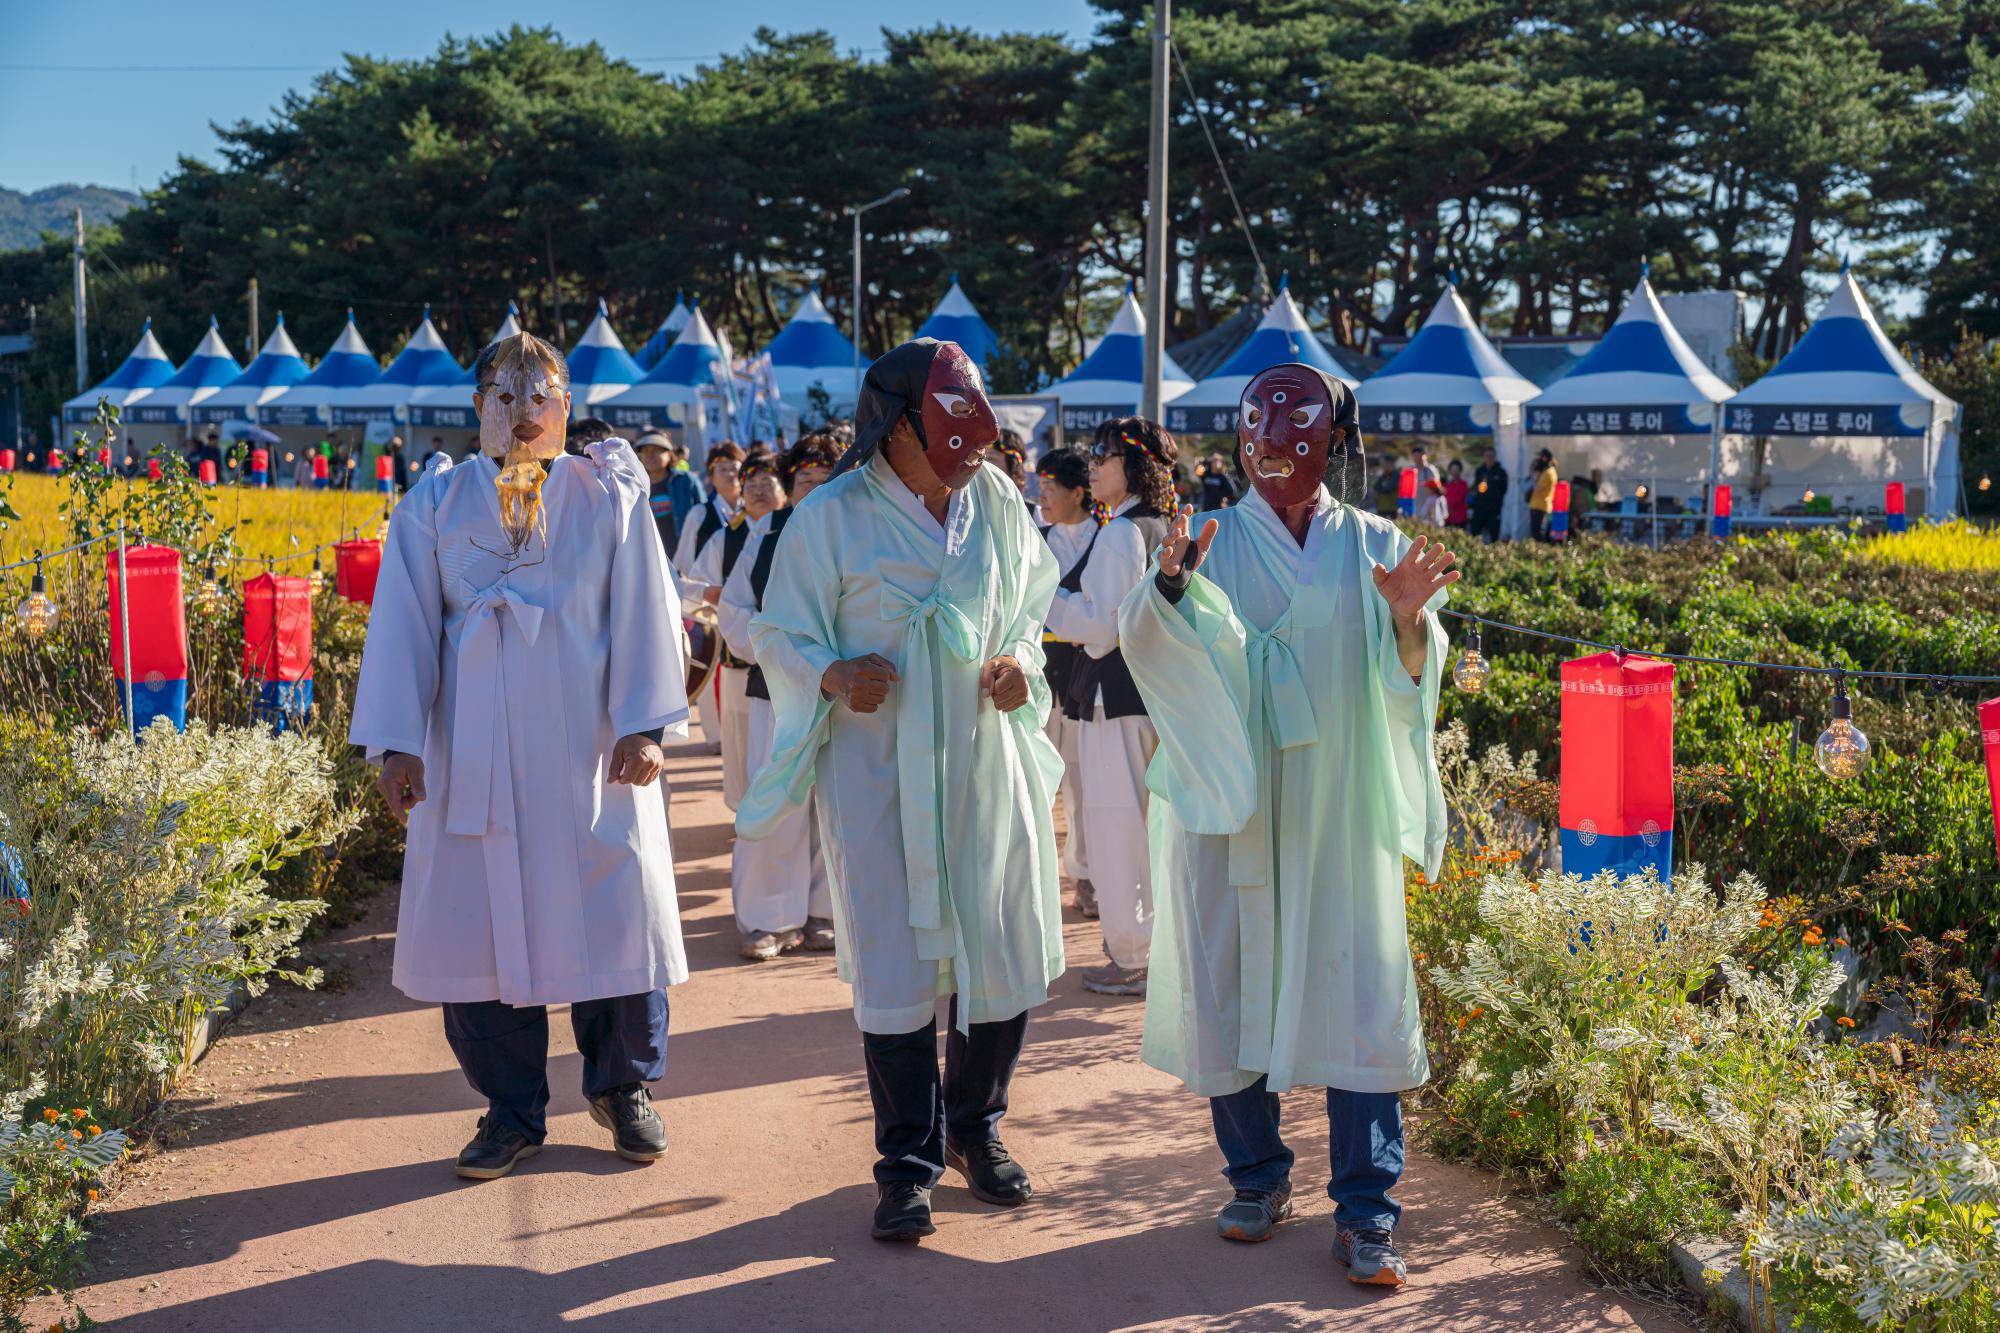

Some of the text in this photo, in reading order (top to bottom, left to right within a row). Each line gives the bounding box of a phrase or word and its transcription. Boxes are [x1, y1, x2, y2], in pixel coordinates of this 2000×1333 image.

[1571, 412, 1621, 432] 스탬프
[1629, 411, 1663, 431] 투어
[1773, 411, 1829, 432] 스탬프
[1837, 411, 1873, 432] 투어
